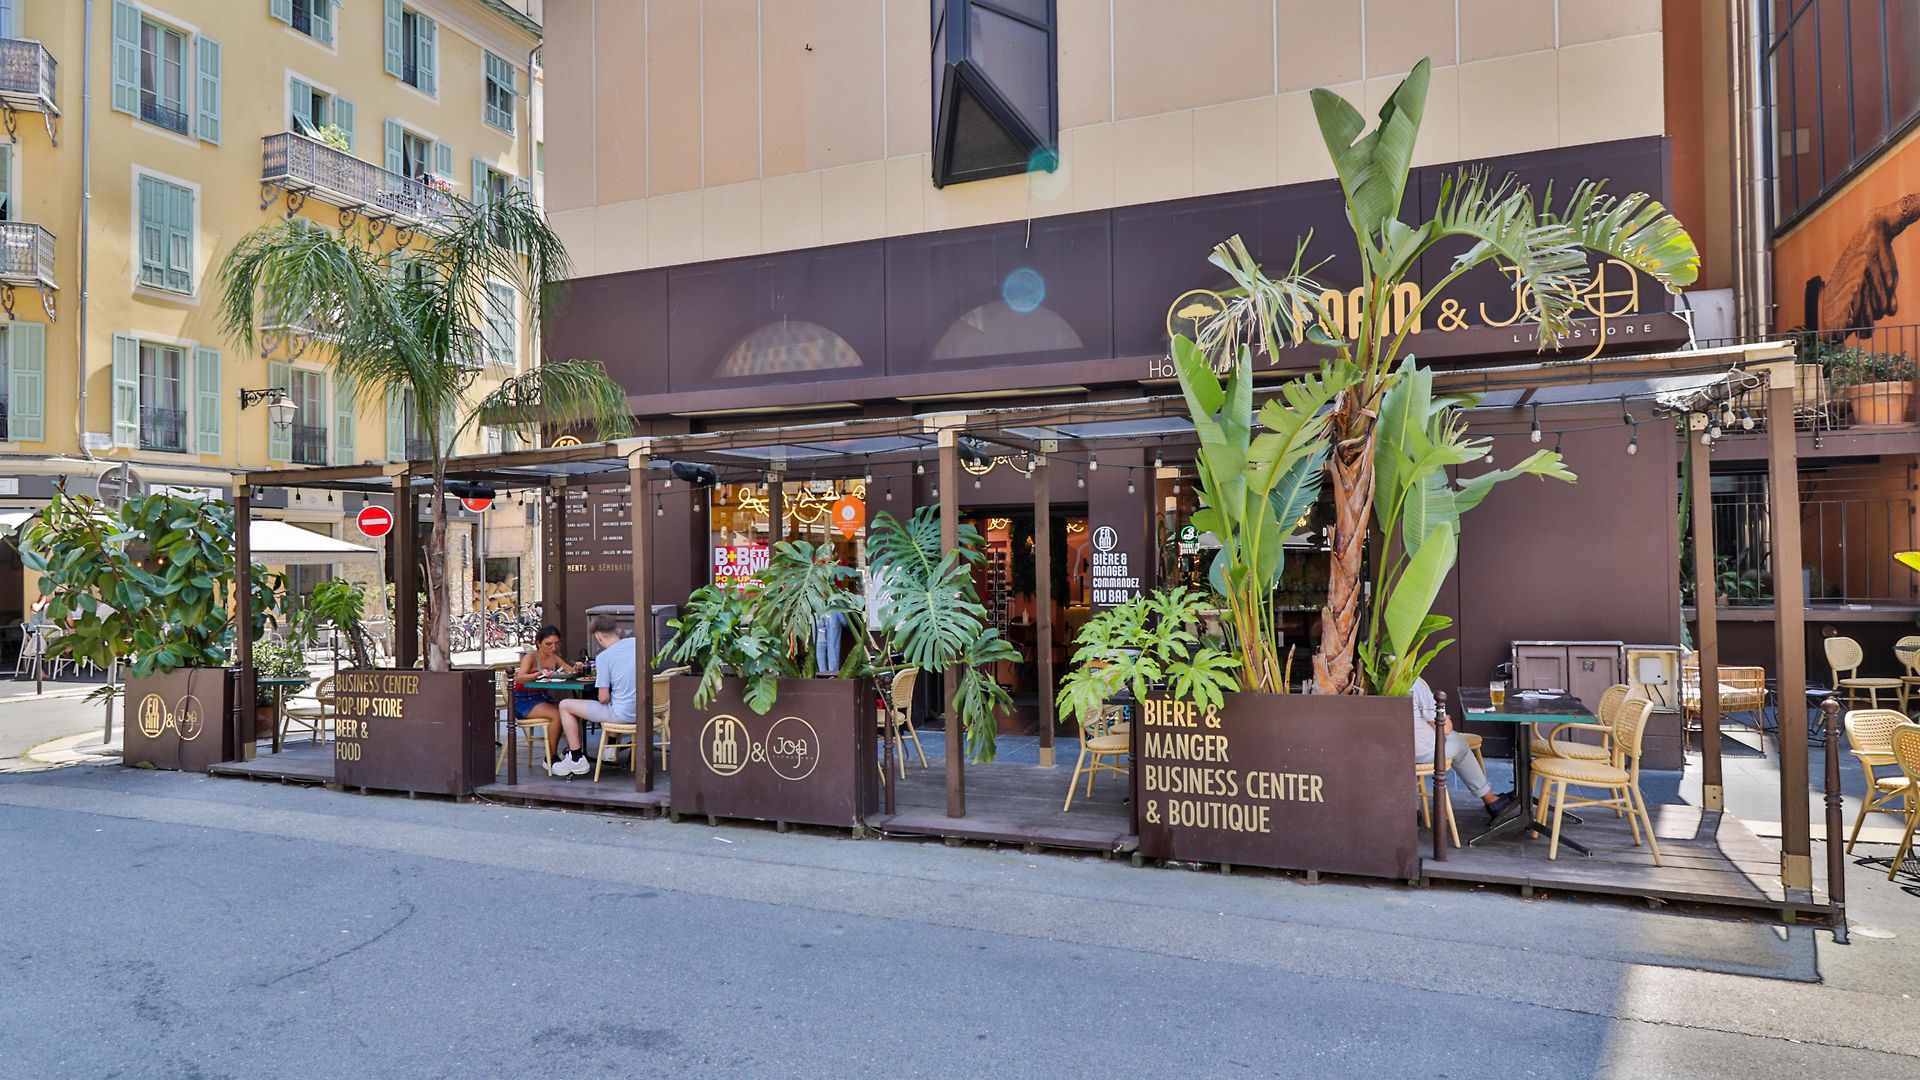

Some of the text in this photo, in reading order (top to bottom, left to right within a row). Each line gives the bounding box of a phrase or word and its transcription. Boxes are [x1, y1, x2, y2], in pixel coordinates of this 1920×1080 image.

[1437, 298, 1469, 332] &
[1513, 324, 1652, 344] LIESTORE
[1093, 551, 1128, 565] BIÈRE &
[715, 565, 750, 576] JOYA
[1093, 565, 1128, 577] MANGER
[1093, 577, 1140, 588] COMMANDEZ
[1093, 589, 1129, 603] AU BAR
[336, 673, 419, 694] BUSINESS CENTER
[336, 696, 403, 718] POP-UP STORE
[1144, 693, 1222, 729] BIÈRE &
[166, 713, 175, 728] &
[336, 718, 369, 739] BEER &
[336, 741, 362, 761] FOOD
[751, 742, 767, 763] &
[1144, 732, 1230, 763] MANGER
[1145, 764, 1324, 803] BUSINESS CENTER
[1145, 799, 1271, 833] & BOUTIQUE
